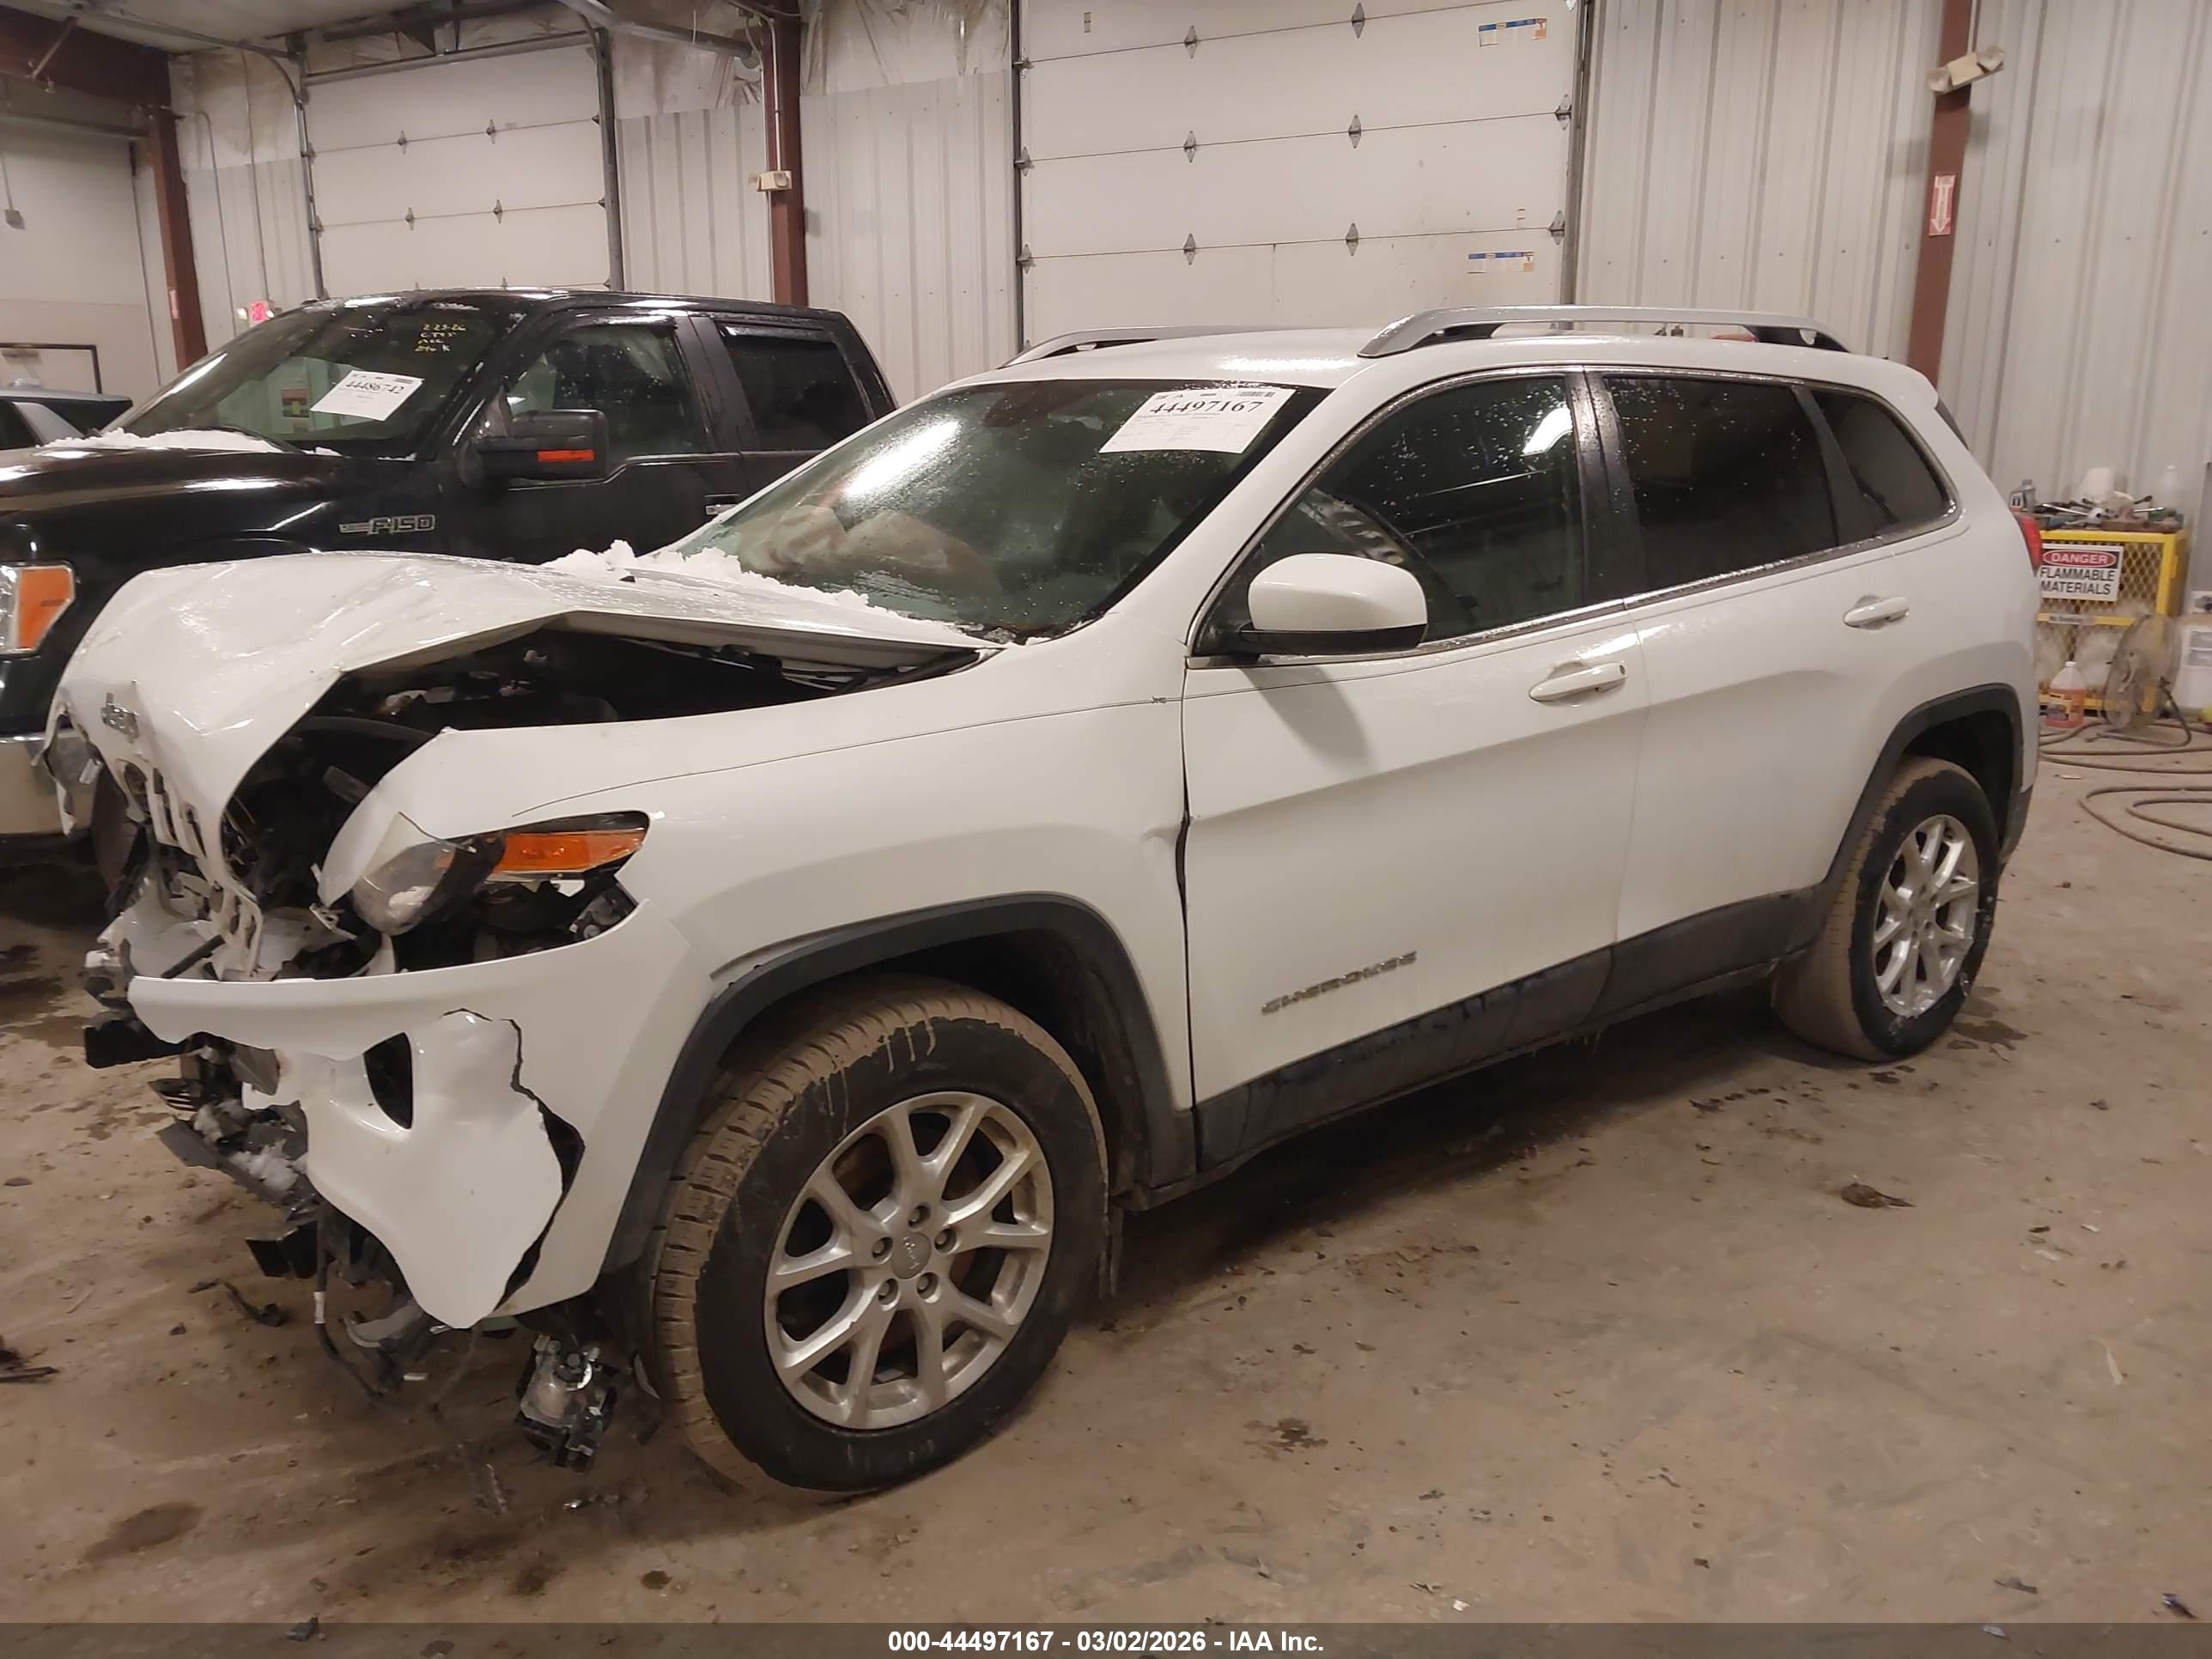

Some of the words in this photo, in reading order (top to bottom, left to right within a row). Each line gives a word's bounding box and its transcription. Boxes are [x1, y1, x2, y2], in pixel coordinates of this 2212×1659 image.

[1150, 400, 1264, 413] 44497167
[2051, 552, 2108, 564] DANGER
[2039, 567, 2115, 581] FLAMMABLE
[2040, 580, 2112, 595] MATERIALS
[1261, 951, 1417, 1015] CHEROKEE
